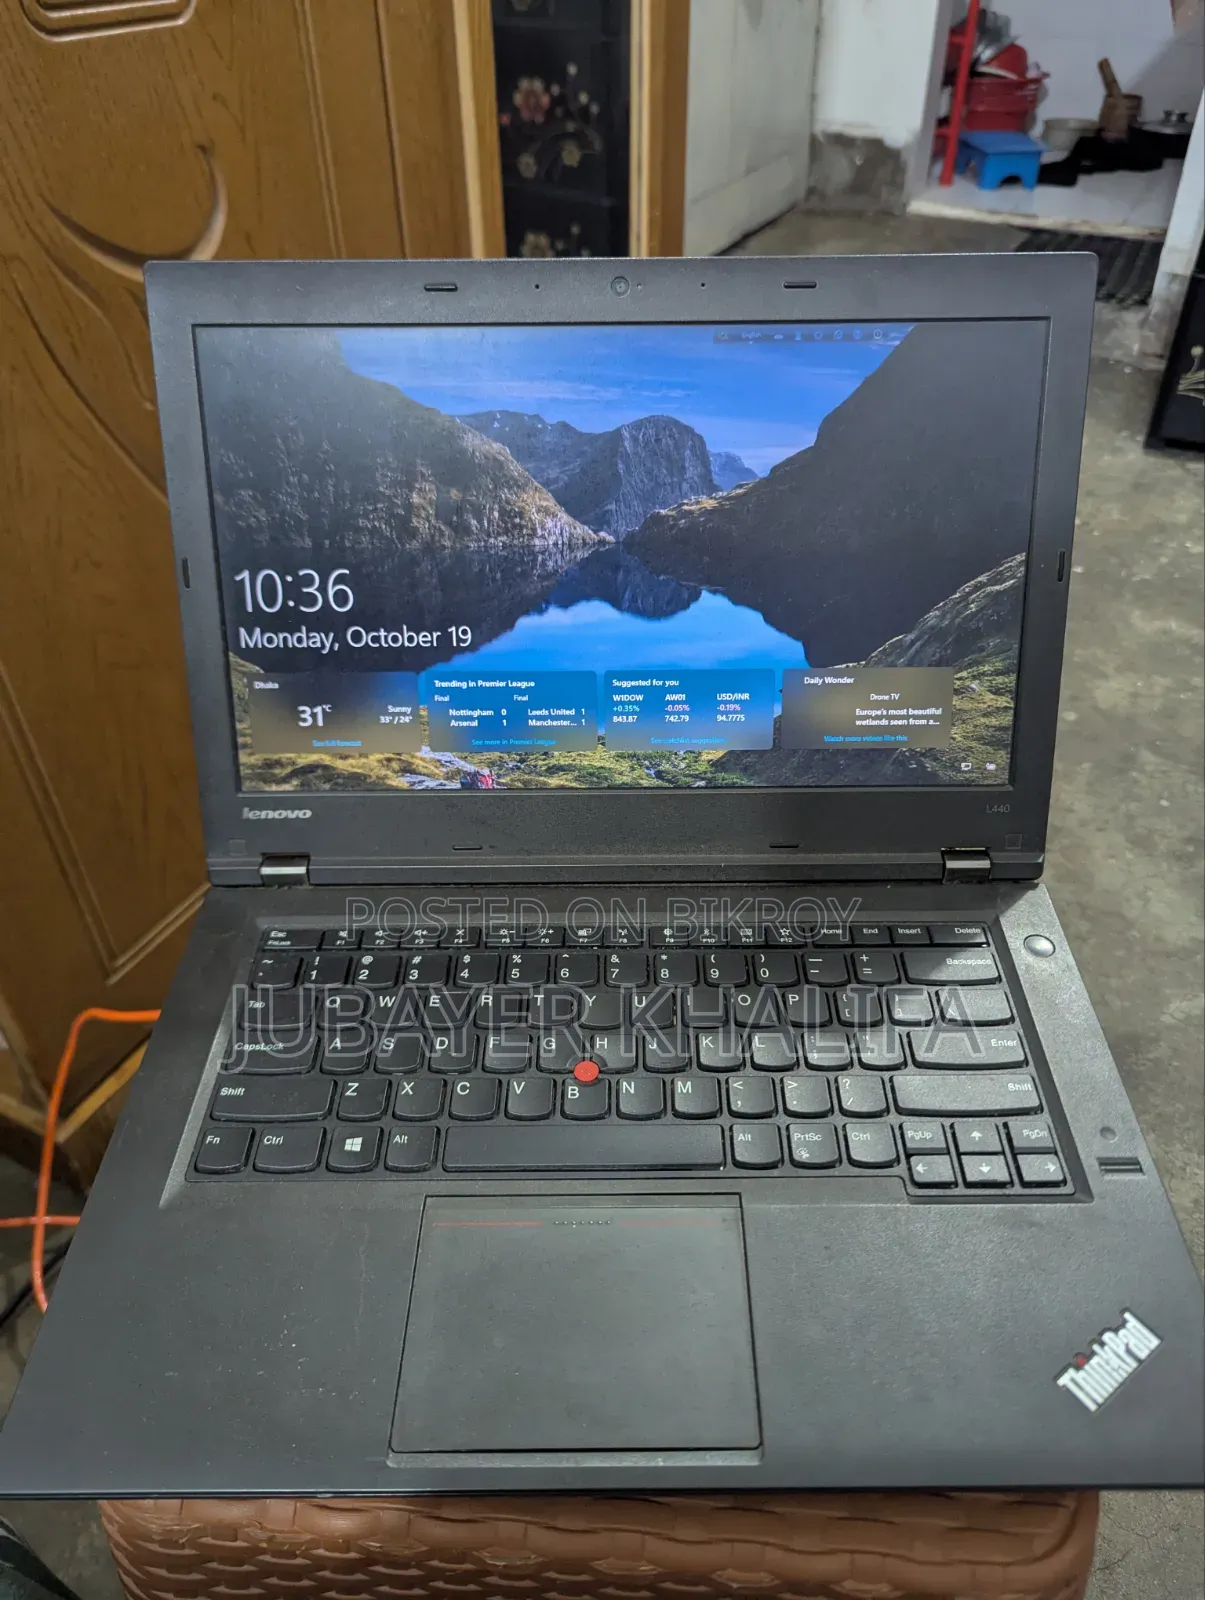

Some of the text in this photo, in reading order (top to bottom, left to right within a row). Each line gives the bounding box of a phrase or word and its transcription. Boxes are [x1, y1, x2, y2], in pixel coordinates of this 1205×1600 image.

[234, 569, 354, 612] 10:36
[239, 624, 472, 654] Monday, October 19
[254, 681, 280, 690] Dhaka
[434, 680, 467, 689] Trending
[508, 680, 535, 688] League
[612, 679, 650, 688] Suggested
[804, 676, 823, 686] Daily
[717, 693, 750, 701] USD/INR
[388, 705, 412, 714] Sunny
[449, 709, 494, 718] Nottingham
[856, 708, 886, 717] Europe's
[242, 807, 312, 820] lenovo
[986, 804, 1010, 814] L440
[362, 956, 374, 964] @
[411, 956, 422, 964] #
[462, 954, 470, 964] $
[512, 954, 522, 964] %
[610, 954, 620, 963] &
[946, 958, 992, 966] Backspace
[310, 970, 318, 980] 1
[358, 970, 370, 980] 2
[408, 970, 419, 980] 3
[460, 968, 470, 978] 4
[511, 968, 520, 978] 5
[560, 968, 570, 978] 6
[610, 968, 620, 978] 7
[660, 968, 670, 978] 8
[710, 968, 720, 978] 9
[760, 968, 770, 978] 0
[248, 1000, 266, 1008] Tab
[326, 996, 340, 1008] Q
[378, 996, 396, 1008] W
[429, 996, 441, 1006] E
[481, 996, 493, 1006] R
[534, 995, 545, 1006] T
[585, 996, 596, 1006] Y
[634, 996, 646, 1008] U
[738, 994, 751, 1006] O
[788, 994, 799, 1006] P
[234, 1042, 284, 1051] CapsLock
[329, 1038, 342, 1050] A
[382, 1038, 394, 1050] S
[436, 1037, 449, 1049] D
[489, 1037, 500, 1049] F
[543, 1037, 556, 1050] G
[596, 1038, 608, 1049] H
[648, 1038, 658, 1049] J
[702, 1036, 714, 1048] K
[754, 1036, 766, 1048] L
[990, 1038, 1018, 1048] Enter
[345, 1082, 360, 1096] Z
[401, 1082, 414, 1096] X
[456, 1082, 470, 1096] C
[512, 1082, 525, 1095] V
[622, 1081, 635, 1094] N
[678, 1080, 692, 1094] M
[842, 1078, 850, 1090] ?
[1008, 1082, 1032, 1092] Shift
[220, 1086, 246, 1096] Shift
[568, 1086, 580, 1100] B
[205, 1136, 220, 1144] Fn
[264, 1135, 284, 1145] Ctrl
[392, 1134, 408, 1144] Alt
[738, 1132, 752, 1142] Alt
[794, 1132, 822, 1142] PrtSc
[851, 1132, 871, 1141] Ctrl
[908, 1130, 932, 1140] PgUp
[1023, 1130, 1048, 1140] PgDn
[1056, 1310, 1162, 1412] ThinkPad
